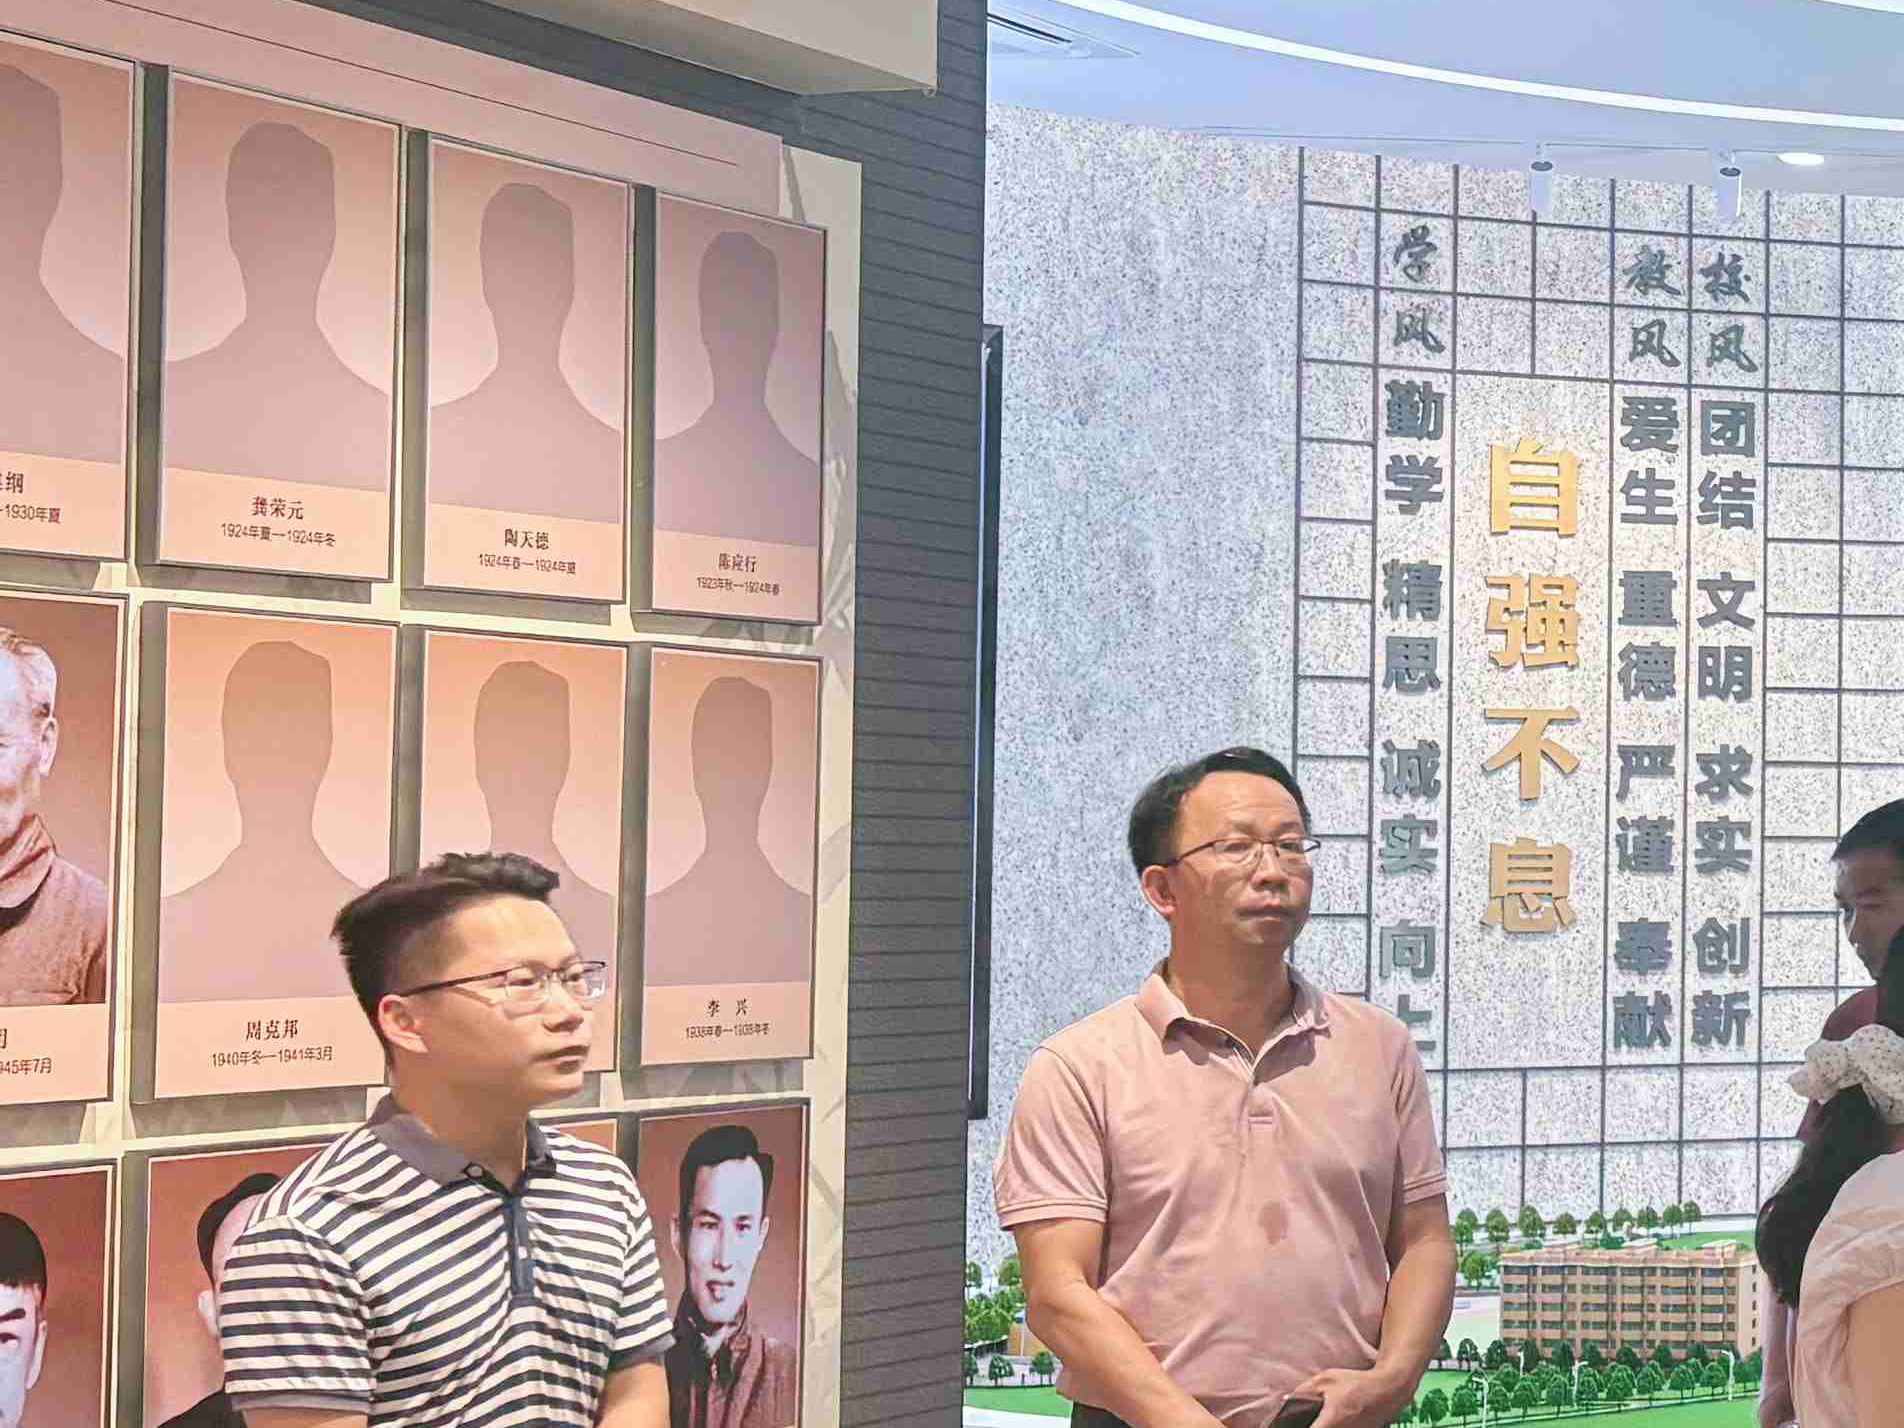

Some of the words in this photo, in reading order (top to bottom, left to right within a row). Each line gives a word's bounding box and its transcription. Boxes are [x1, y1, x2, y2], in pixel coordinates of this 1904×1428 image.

[1394, 225, 1445, 353] 学风
[1624, 245, 1681, 368] 教风
[1700, 252, 1758, 372] 校风
[0, 471, 24, 494] 纲
[1384, 379, 1444, 515] 勤学
[1619, 396, 1679, 526] 爱生
[1697, 399, 1756, 530] 团结
[1383, 558, 1442, 695] 精思
[1480, 436, 1580, 933] 自强不息
[1618, 570, 1677, 701] 重德
[1697, 572, 1755, 701] 文明
[1381, 739, 1440, 874] 诚实
[1616, 745, 1676, 875] 严谨
[1694, 744, 1754, 874] 求实
[1613, 918, 1671, 1049] 奉献
[1691, 917, 1750, 1047] 创新
